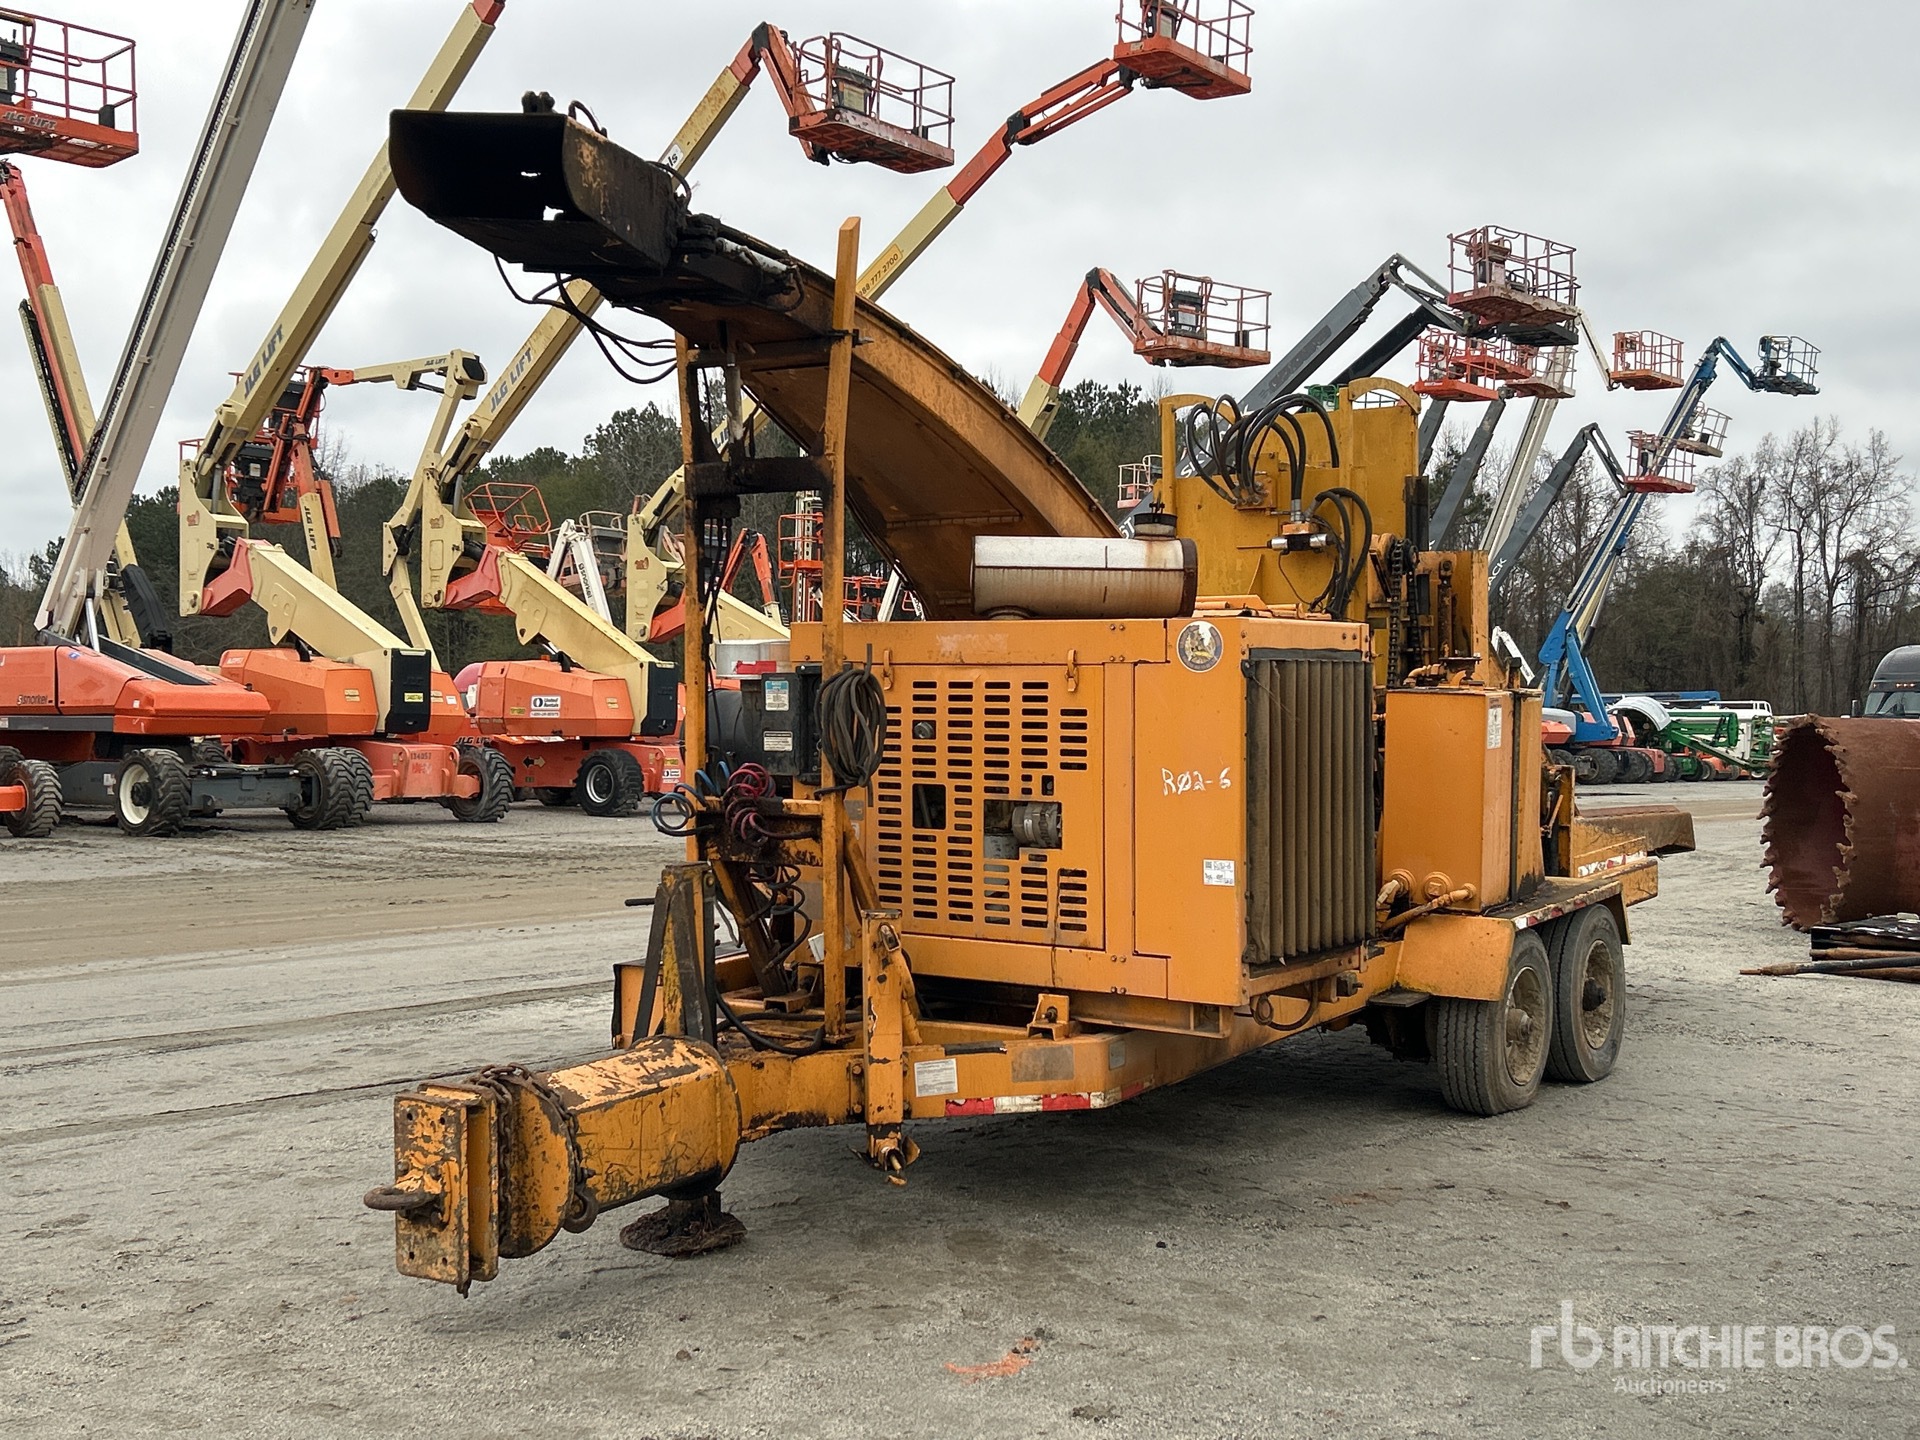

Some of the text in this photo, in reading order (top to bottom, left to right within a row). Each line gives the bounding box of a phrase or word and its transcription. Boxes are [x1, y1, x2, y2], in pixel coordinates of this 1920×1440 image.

[3, 111, 57, 130] JLG LIFT
[882, 253, 899, 273] 2700
[244, 324, 283, 399] JLG LIFT
[435, 357, 447, 365] LIFT
[490, 347, 532, 413] JLG LIFT
[304, 506, 318, 551] JLG LIFT
[1488, 558, 1507, 591] ACK
[455, 737, 474, 745] JLG
